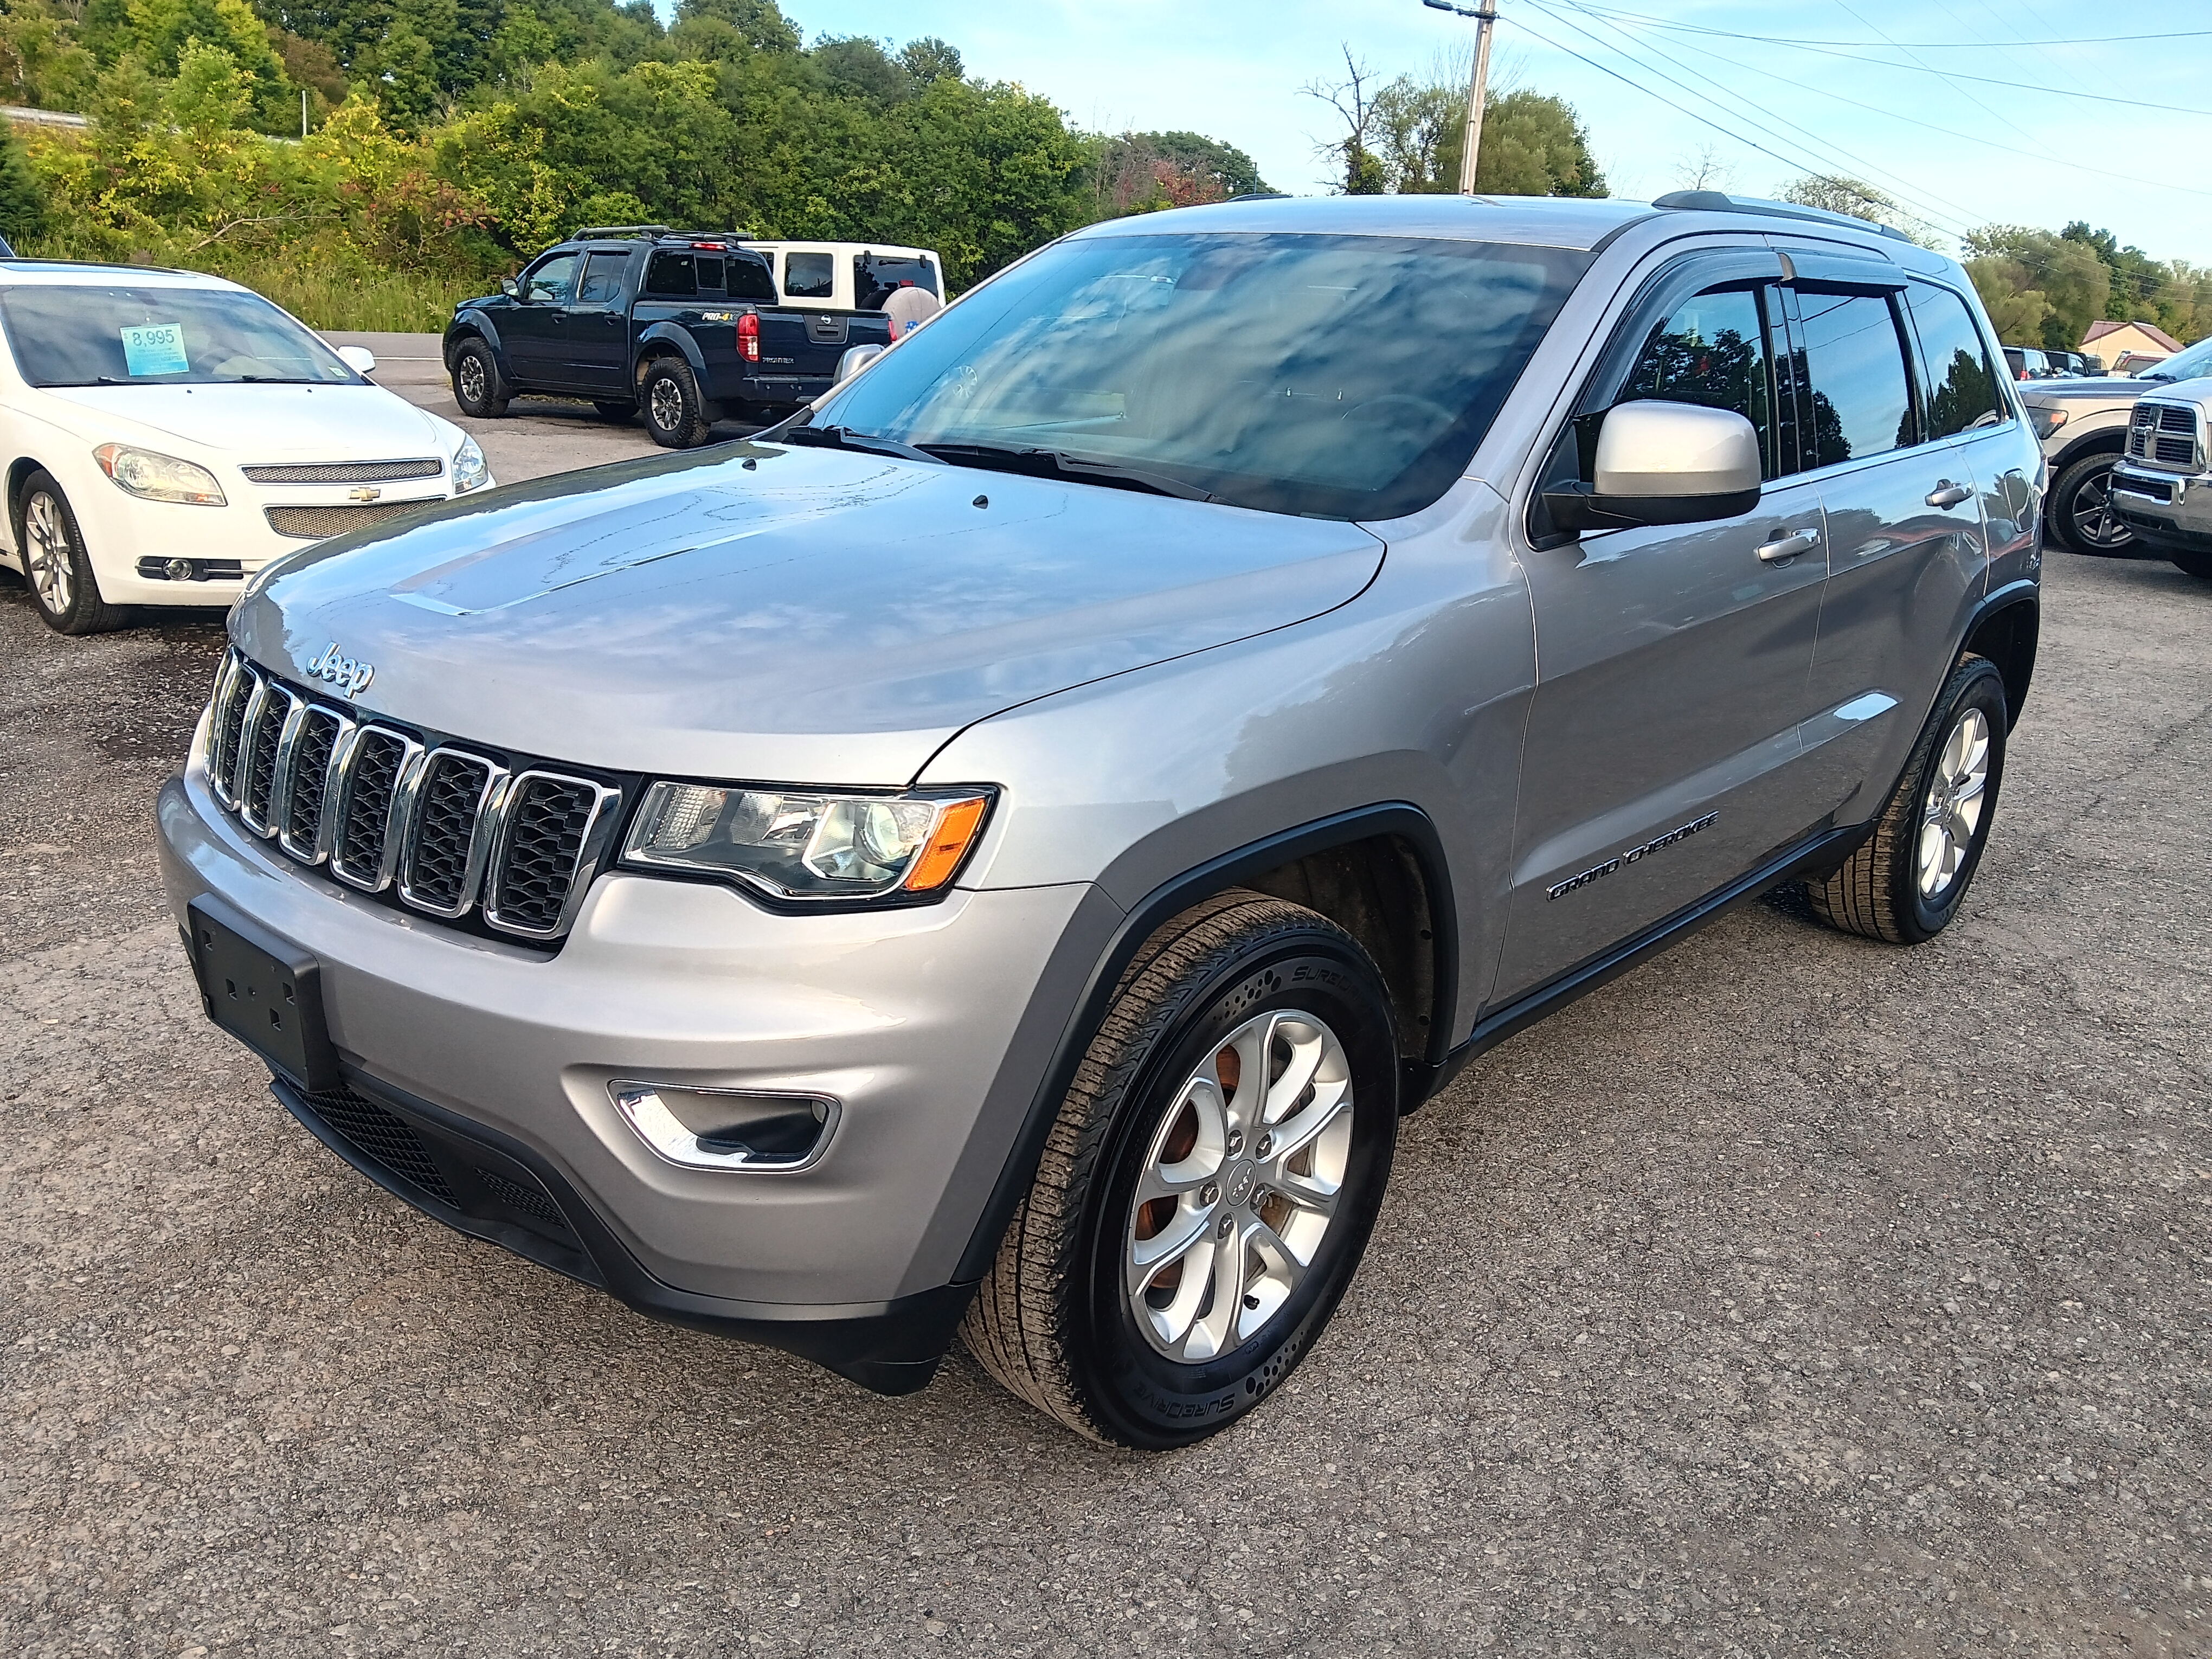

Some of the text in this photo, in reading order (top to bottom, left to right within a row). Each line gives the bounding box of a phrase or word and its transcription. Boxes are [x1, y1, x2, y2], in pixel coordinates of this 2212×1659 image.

[702, 312, 736, 321] PRO-4X
[132, 329, 175, 348] 8,995
[307, 641, 375, 700] Jeep
[1546, 809, 1719, 902] GRAND CHEROKEE
